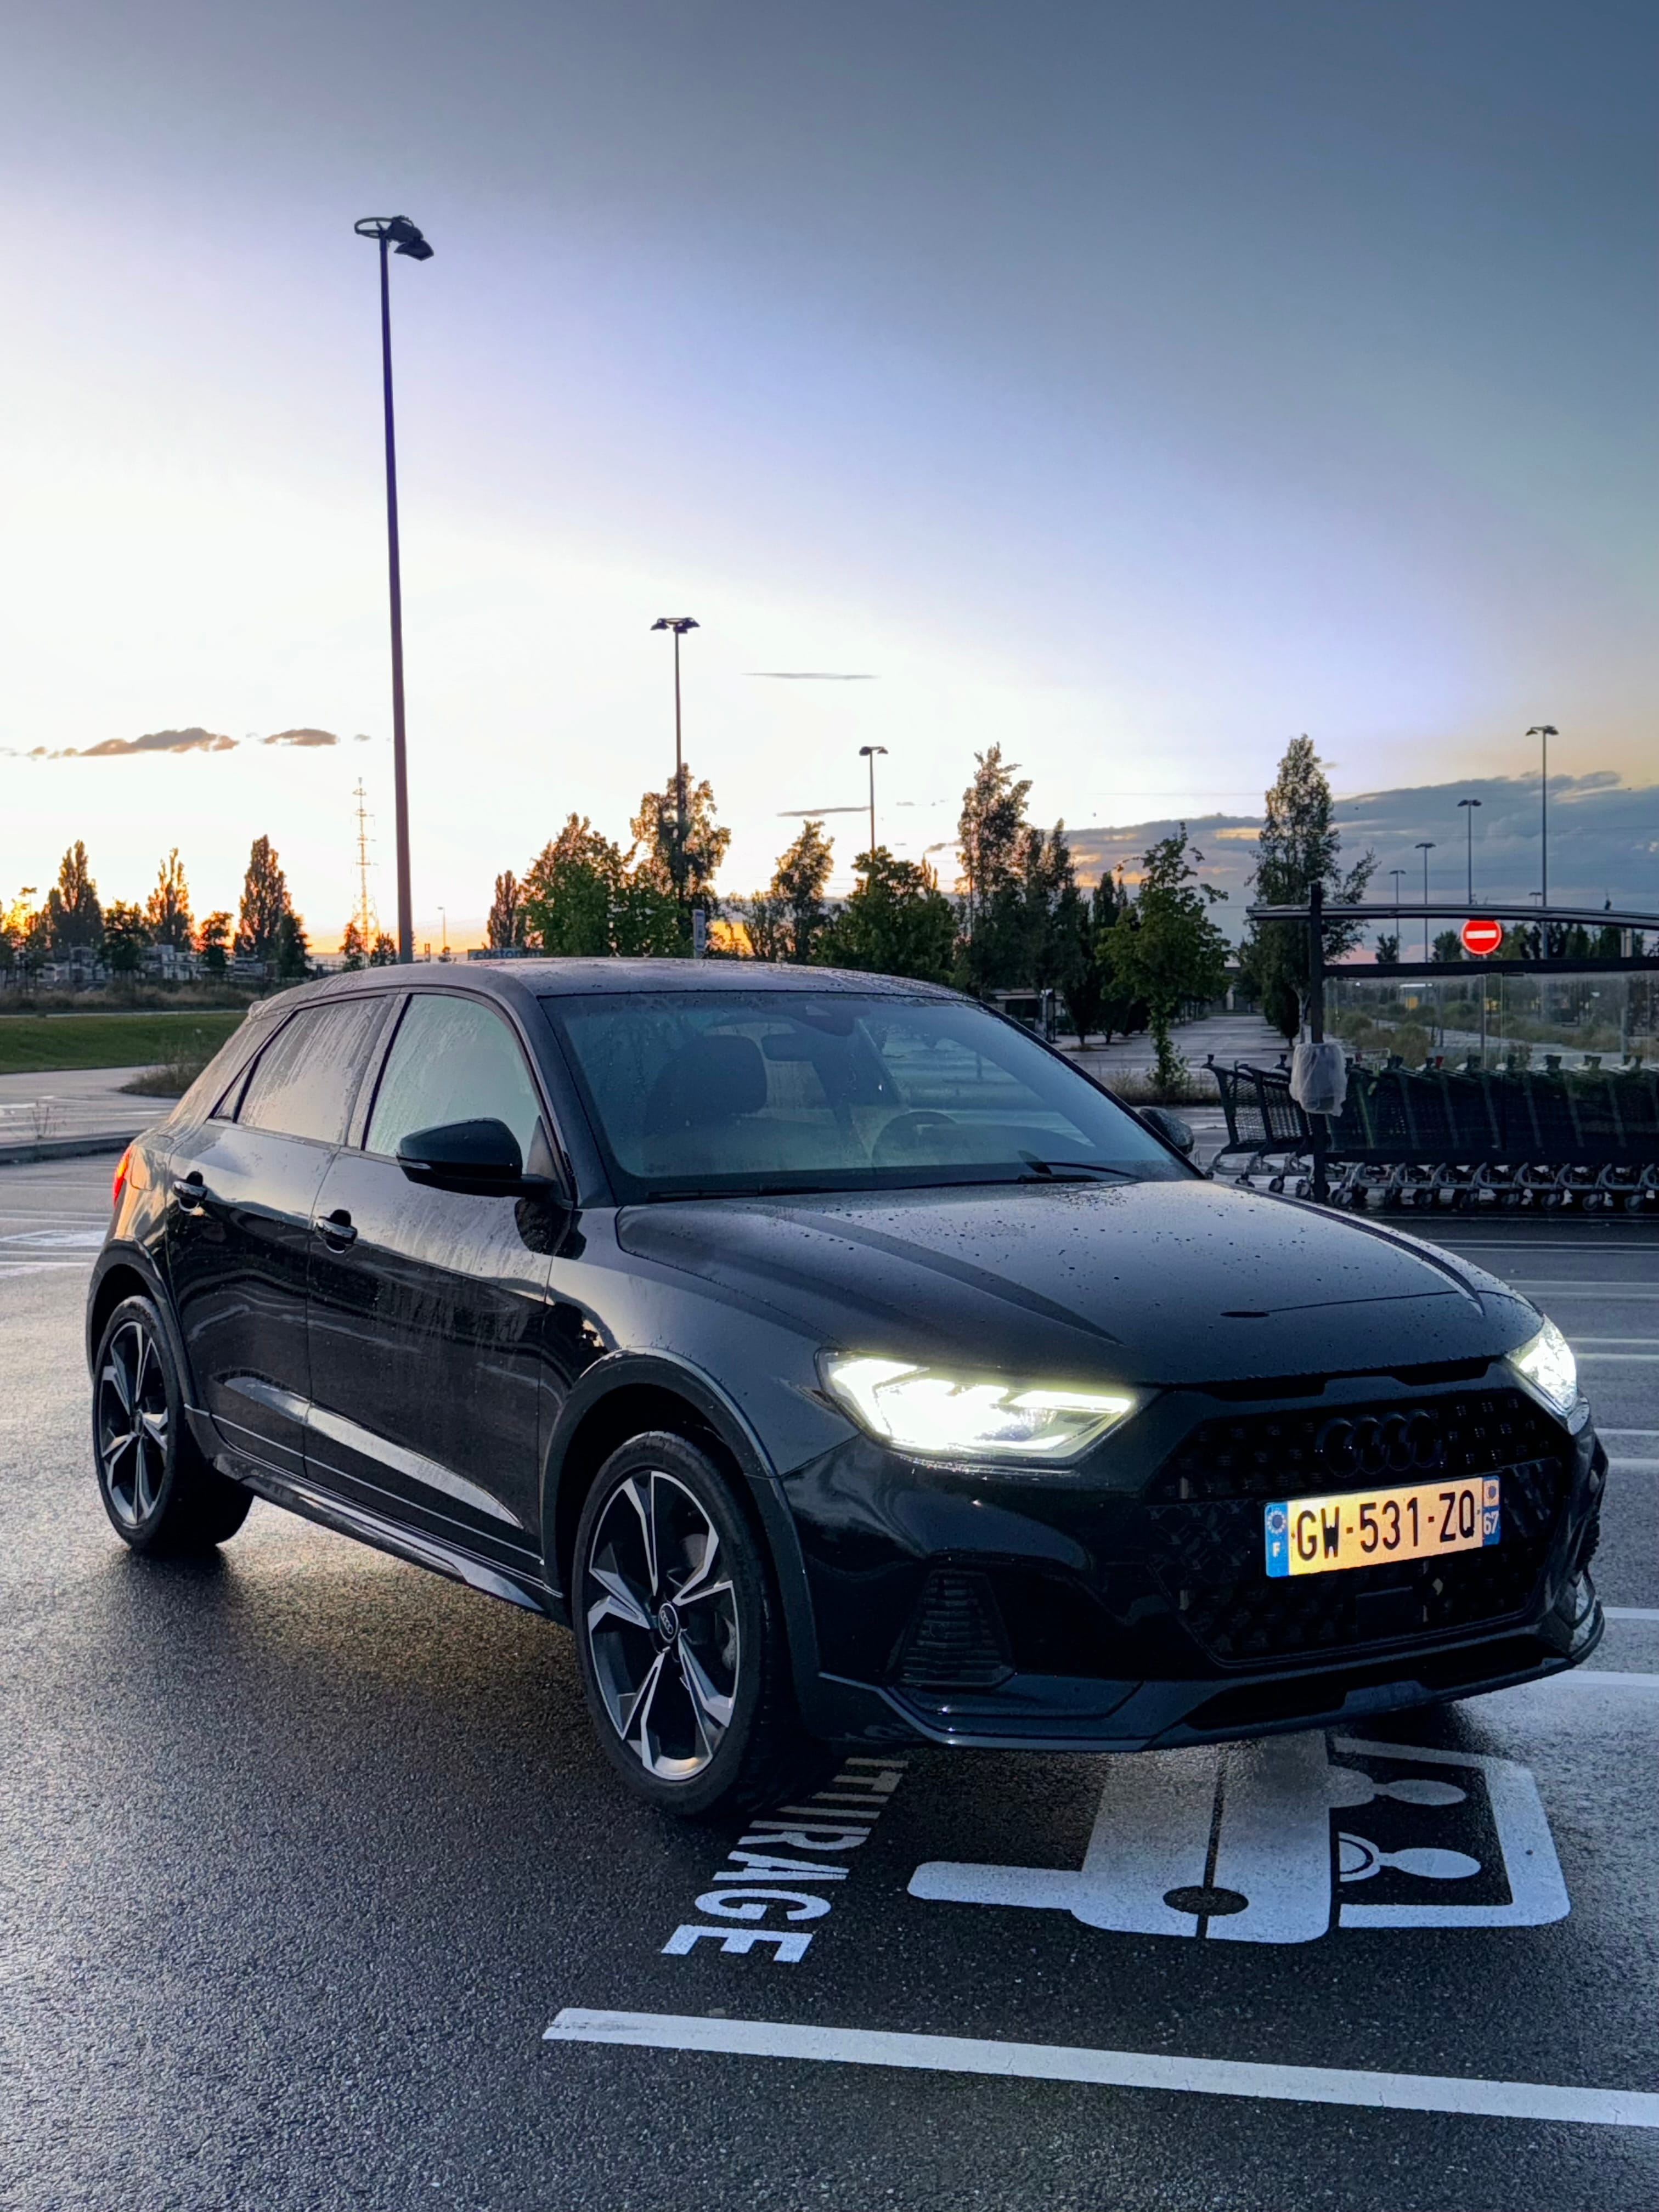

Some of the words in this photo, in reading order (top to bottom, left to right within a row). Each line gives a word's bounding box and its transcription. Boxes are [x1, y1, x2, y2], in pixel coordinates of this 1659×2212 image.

[1297, 1489, 1475, 1561] GW-531-ZQ
[1483, 1510, 1499, 1534] 67
[1272, 1541, 1281, 1558] F
